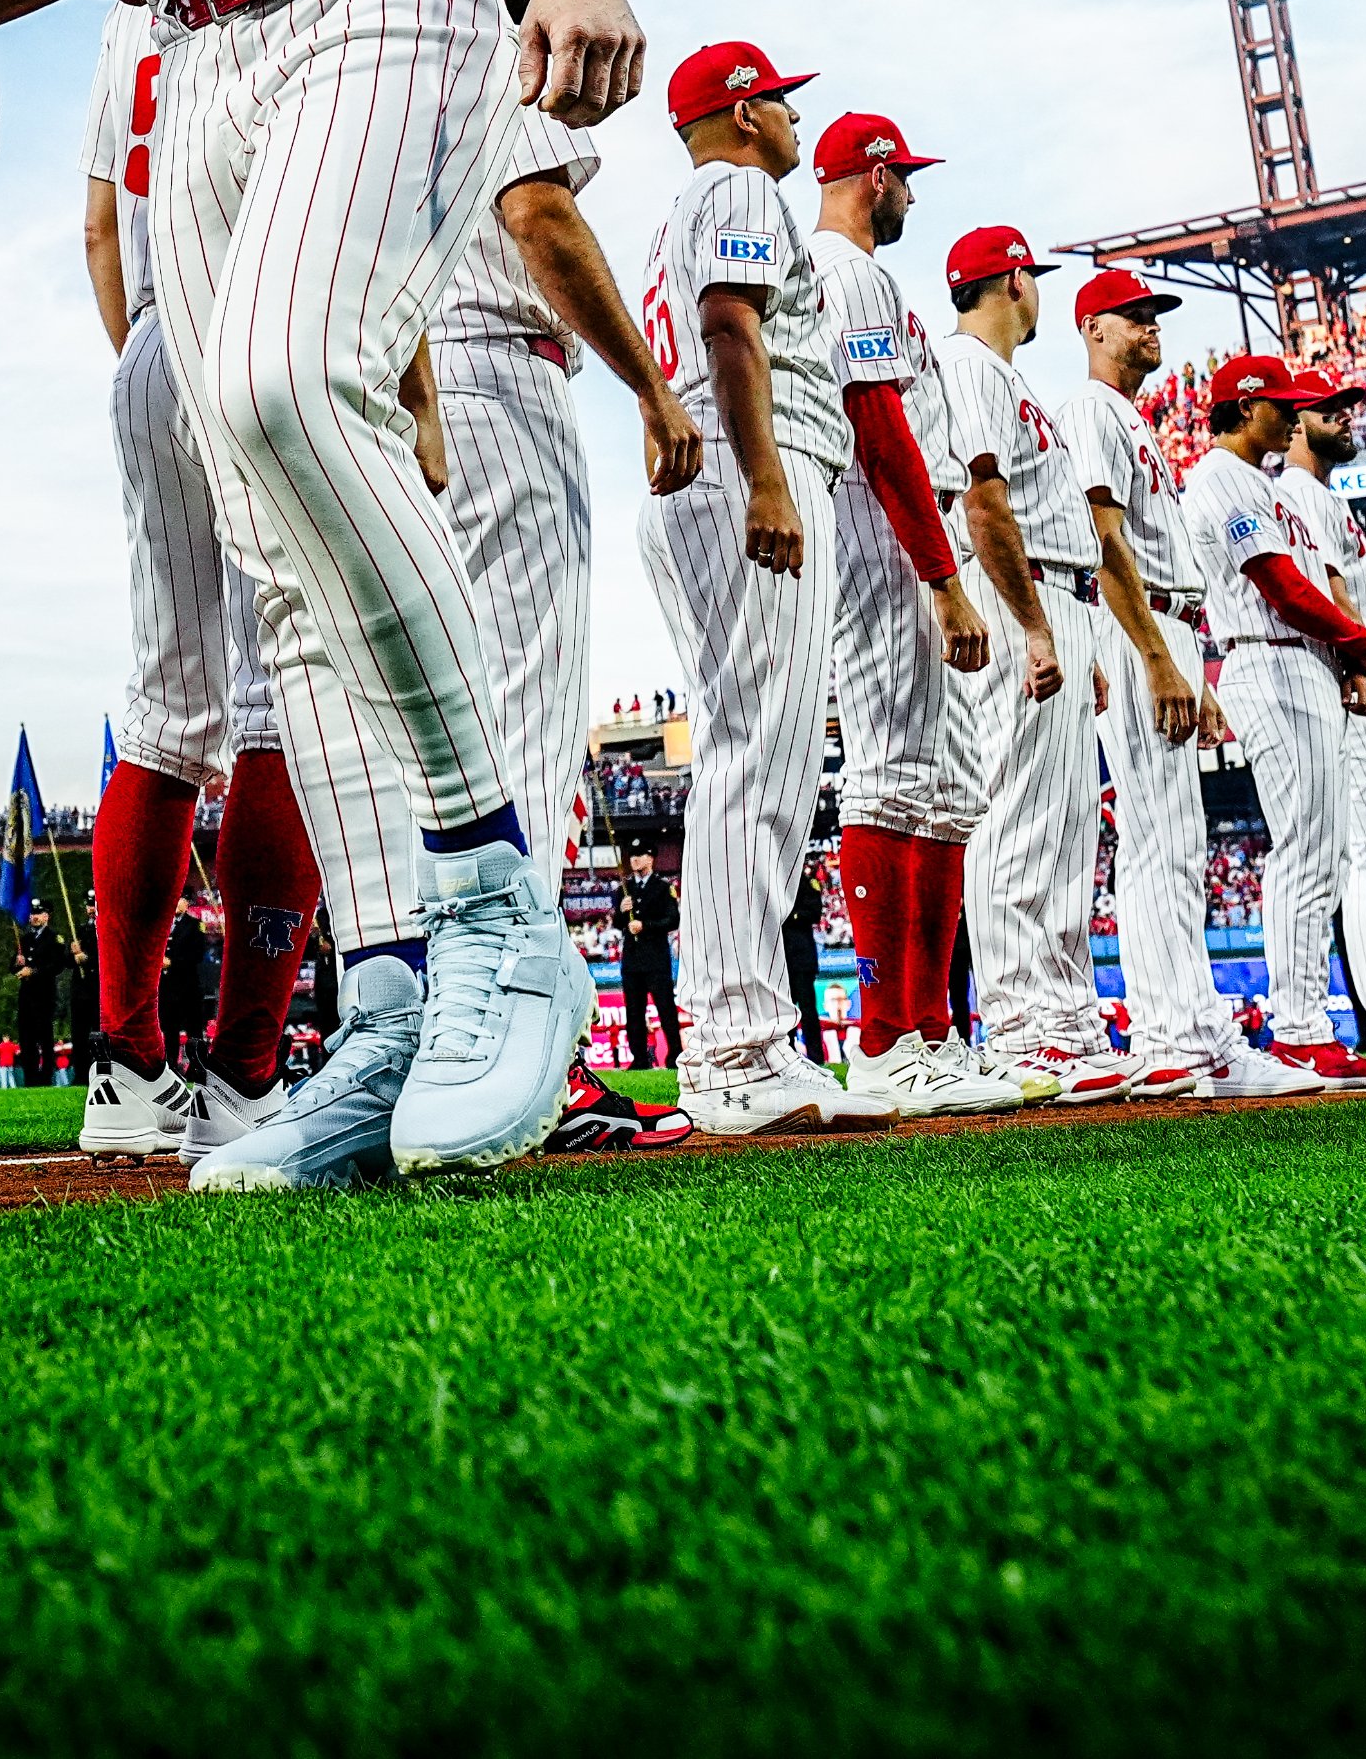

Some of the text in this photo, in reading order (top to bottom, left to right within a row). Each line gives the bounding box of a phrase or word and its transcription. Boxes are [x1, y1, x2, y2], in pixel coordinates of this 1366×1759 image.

[720, 239, 771, 261] IBX
[847, 337, 894, 359] IBX
[1230, 518, 1262, 542] IBX
[565, 1123, 600, 1149] MINIMUS
